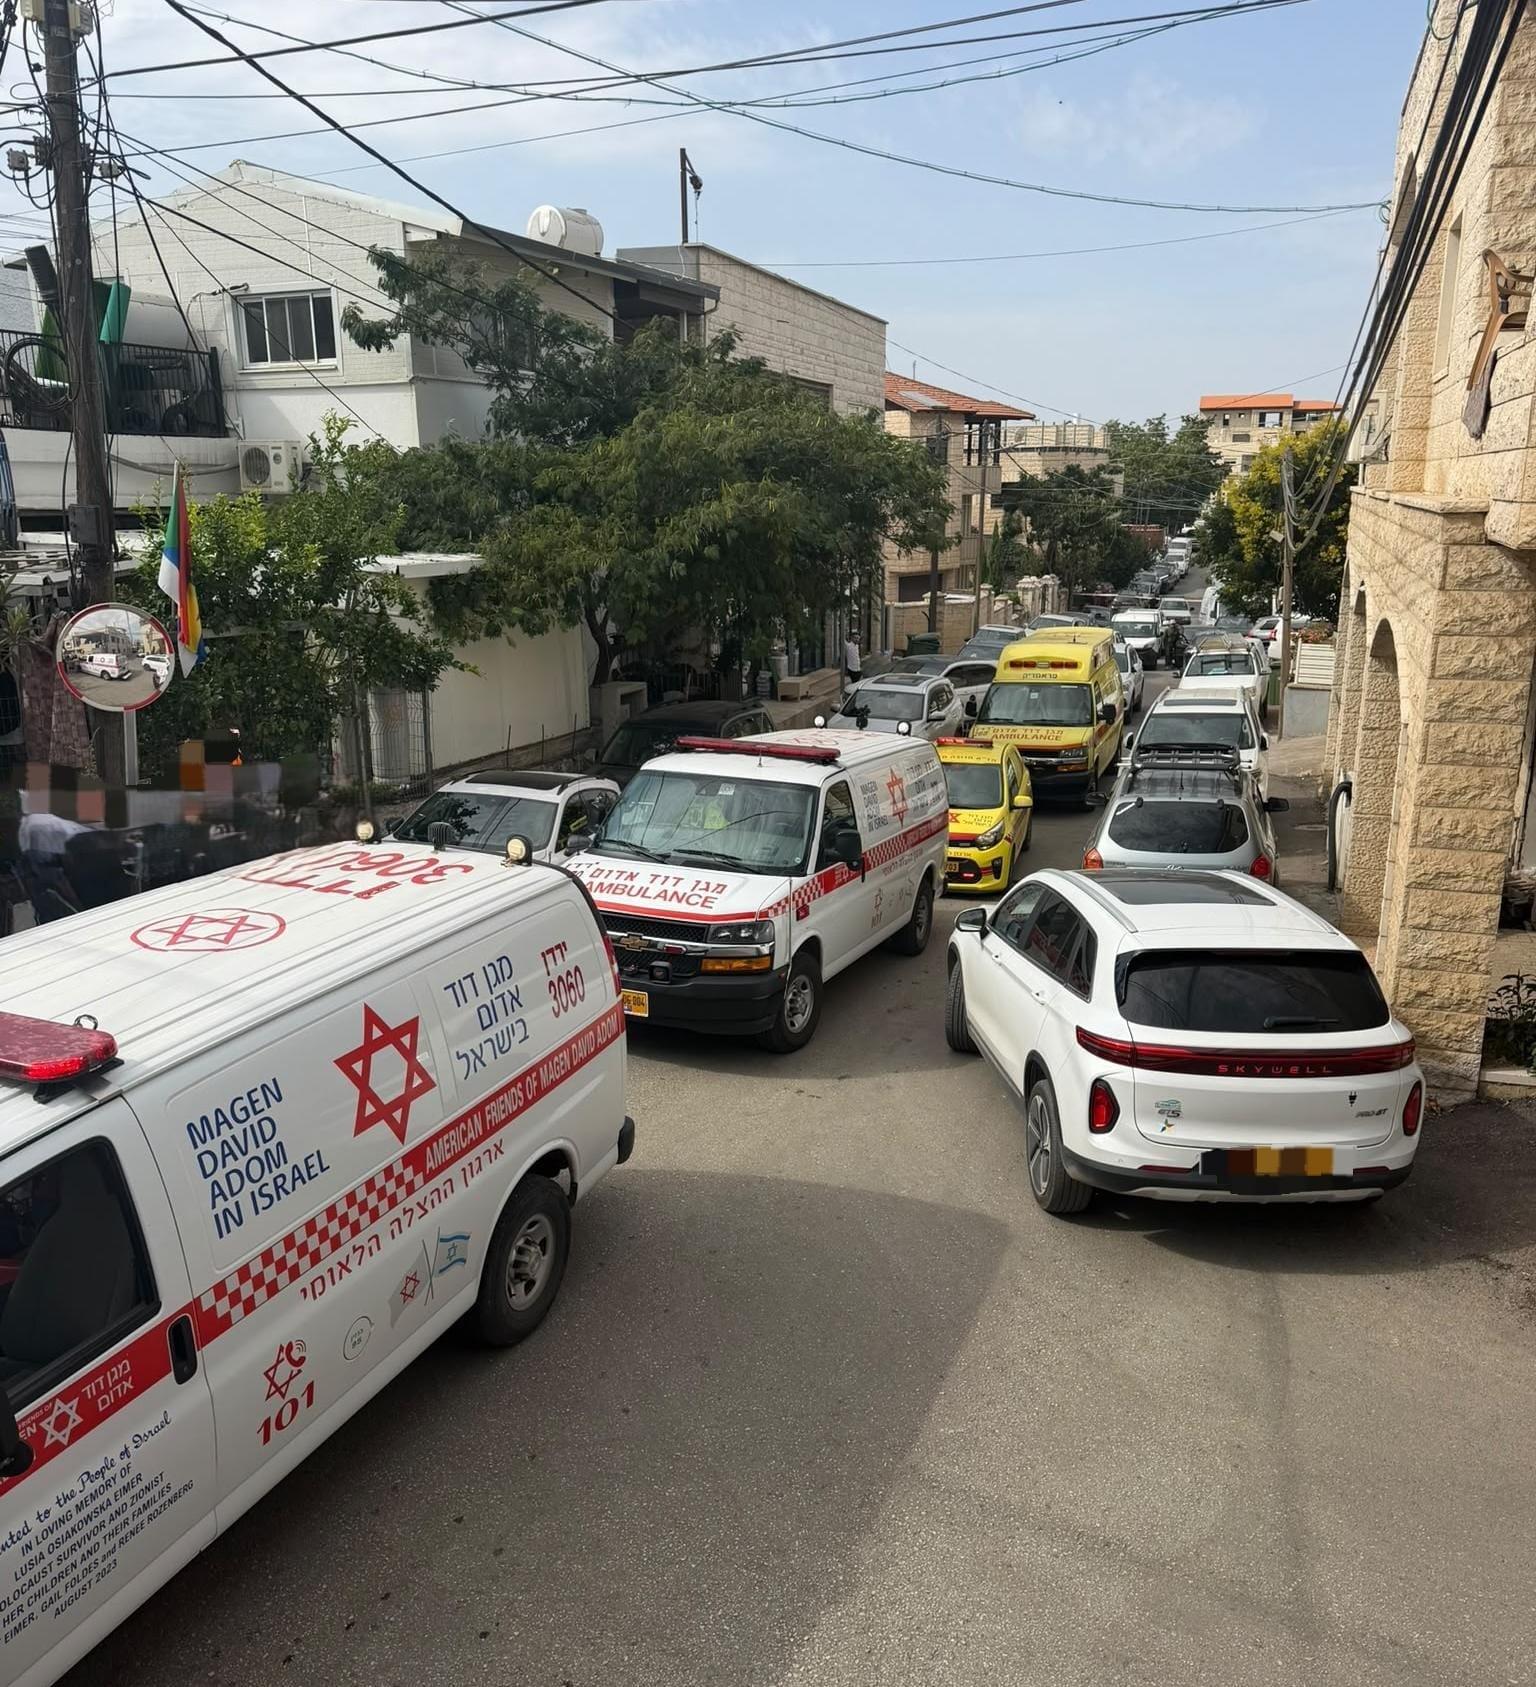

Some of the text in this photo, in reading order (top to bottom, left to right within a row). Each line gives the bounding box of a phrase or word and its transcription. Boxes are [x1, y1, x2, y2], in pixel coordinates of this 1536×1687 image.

[991, 733, 1063, 741] AMBULANCE
[585, 880, 719, 910] AMBULANCE
[589, 867, 640, 882] אדום
[649, 873, 685, 887] דוד
[689, 880, 729, 895] מגן
[443, 955, 514, 1008] מגן דוד
[541, 941, 568, 977] ירדן
[476, 984, 524, 1032] אדום
[548, 965, 585, 1018] 3060
[456, 1018, 530, 1080] בישראל
[1217, 1064, 1334, 1074] SKYWELL
[186, 1077, 283, 1150] MAGEN
[425, 1011, 618, 1174] AMERICAN FRIENDS OF MAGEN DAVID ADOM
[196, 1116, 277, 1180] DAVID
[211, 1141, 289, 1210] ADOM
[213, 1149, 331, 1240] IN ISRAEL
[300, 1138, 505, 1301] ארגון ההצלה הלאומי
[81, 1359, 131, 1400] מגן דוד
[97, 1375, 134, 1412] אדום
[256, 1380, 314, 1446] 101
[36, 1507, 52, 1523] to
[55, 1489, 77, 1508] the
[77, 1456, 117, 1493] People
[119, 1444, 132, 1460] of
[132, 1410, 172, 1450] Israel
[14, 1472, 143, 1582] LUSIA OSIAKOWSKA EIMER
[21, 1463, 133, 1557] IN LOVING MEMORY OF
[0, 1471, 165, 1612] OLOCAUST SURVIVOR AND ZIONIST
[2, 1482, 172, 1628] HER CHILDREN AND THEIR FAMILIES
[41, 1590, 63, 1613] GAIL
[64, 1561, 99, 1594] FOLDES
[101, 1544, 117, 1562] and
[117, 1522, 146, 1549] RENEE
[147, 1479, 194, 1525] ROZENBERG
[53, 1558, 118, 1620] AUGUST 2023
